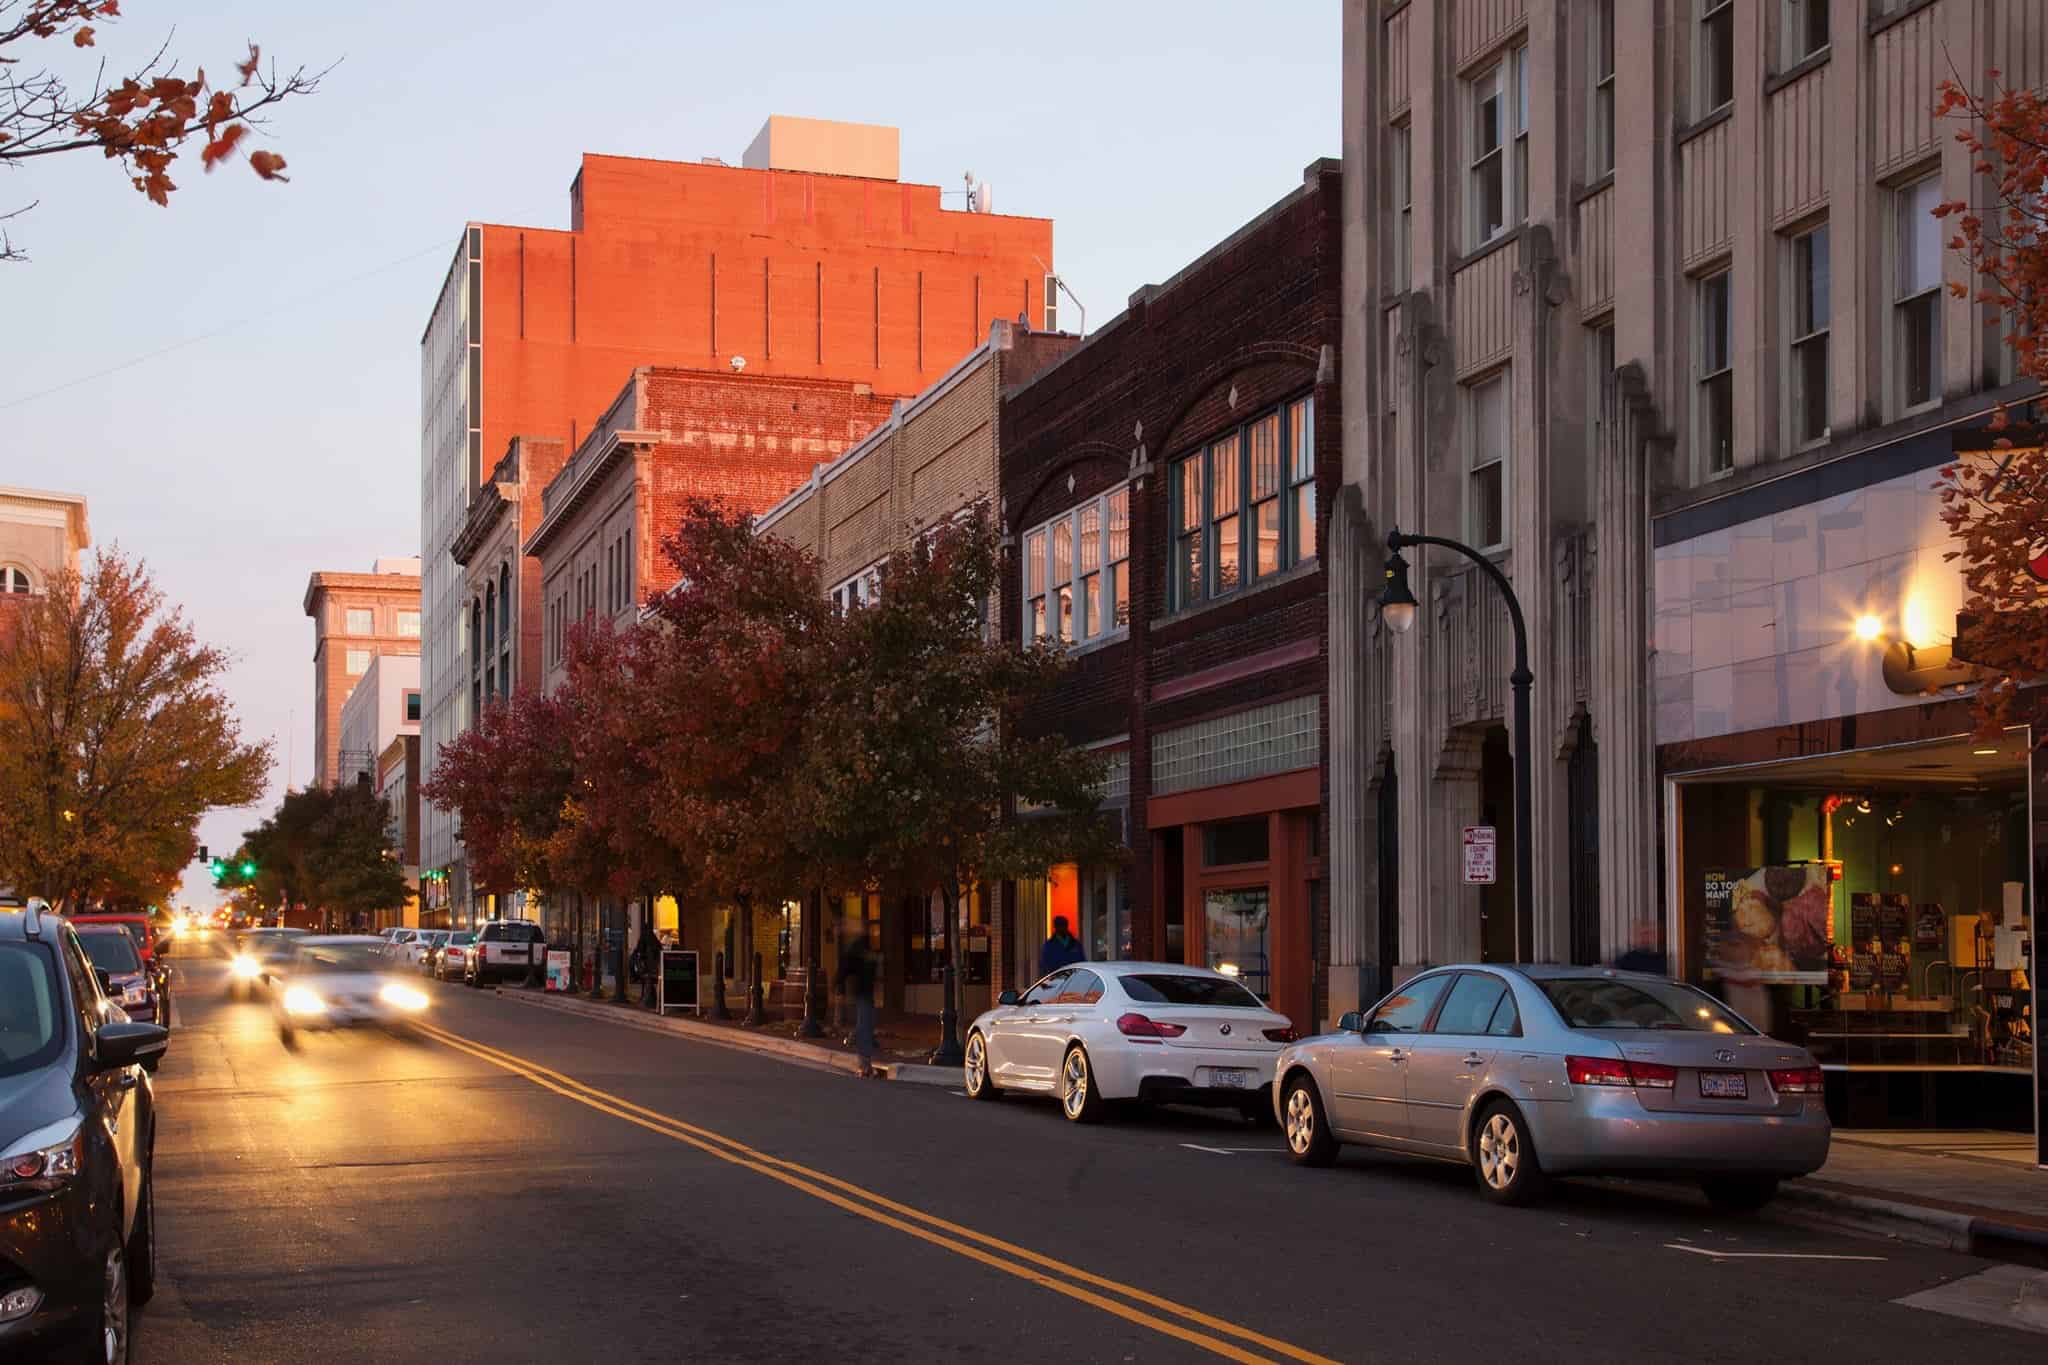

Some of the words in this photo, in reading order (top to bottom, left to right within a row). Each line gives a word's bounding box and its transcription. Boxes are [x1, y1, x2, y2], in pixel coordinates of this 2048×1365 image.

[1705, 872, 1726, 881] HOW
[1705, 881, 1718, 890] DO
[1705, 890, 1730, 899] WANT
